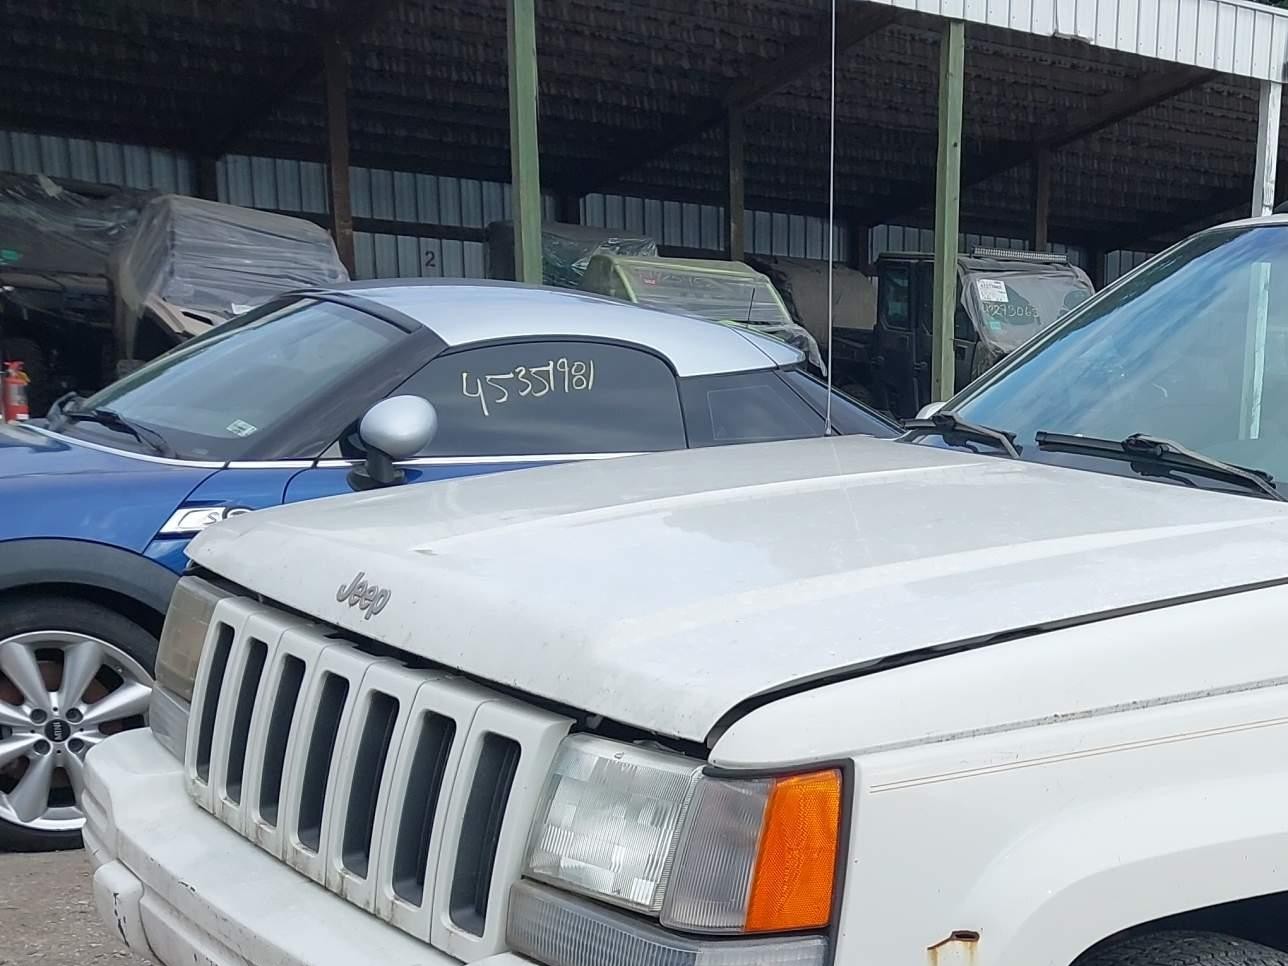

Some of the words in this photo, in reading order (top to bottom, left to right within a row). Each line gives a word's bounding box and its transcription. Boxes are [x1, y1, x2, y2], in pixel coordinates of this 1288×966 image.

[425, 250, 436, 267] 2
[462, 358, 594, 416] 45351981
[336, 571, 392, 620] Jeep
